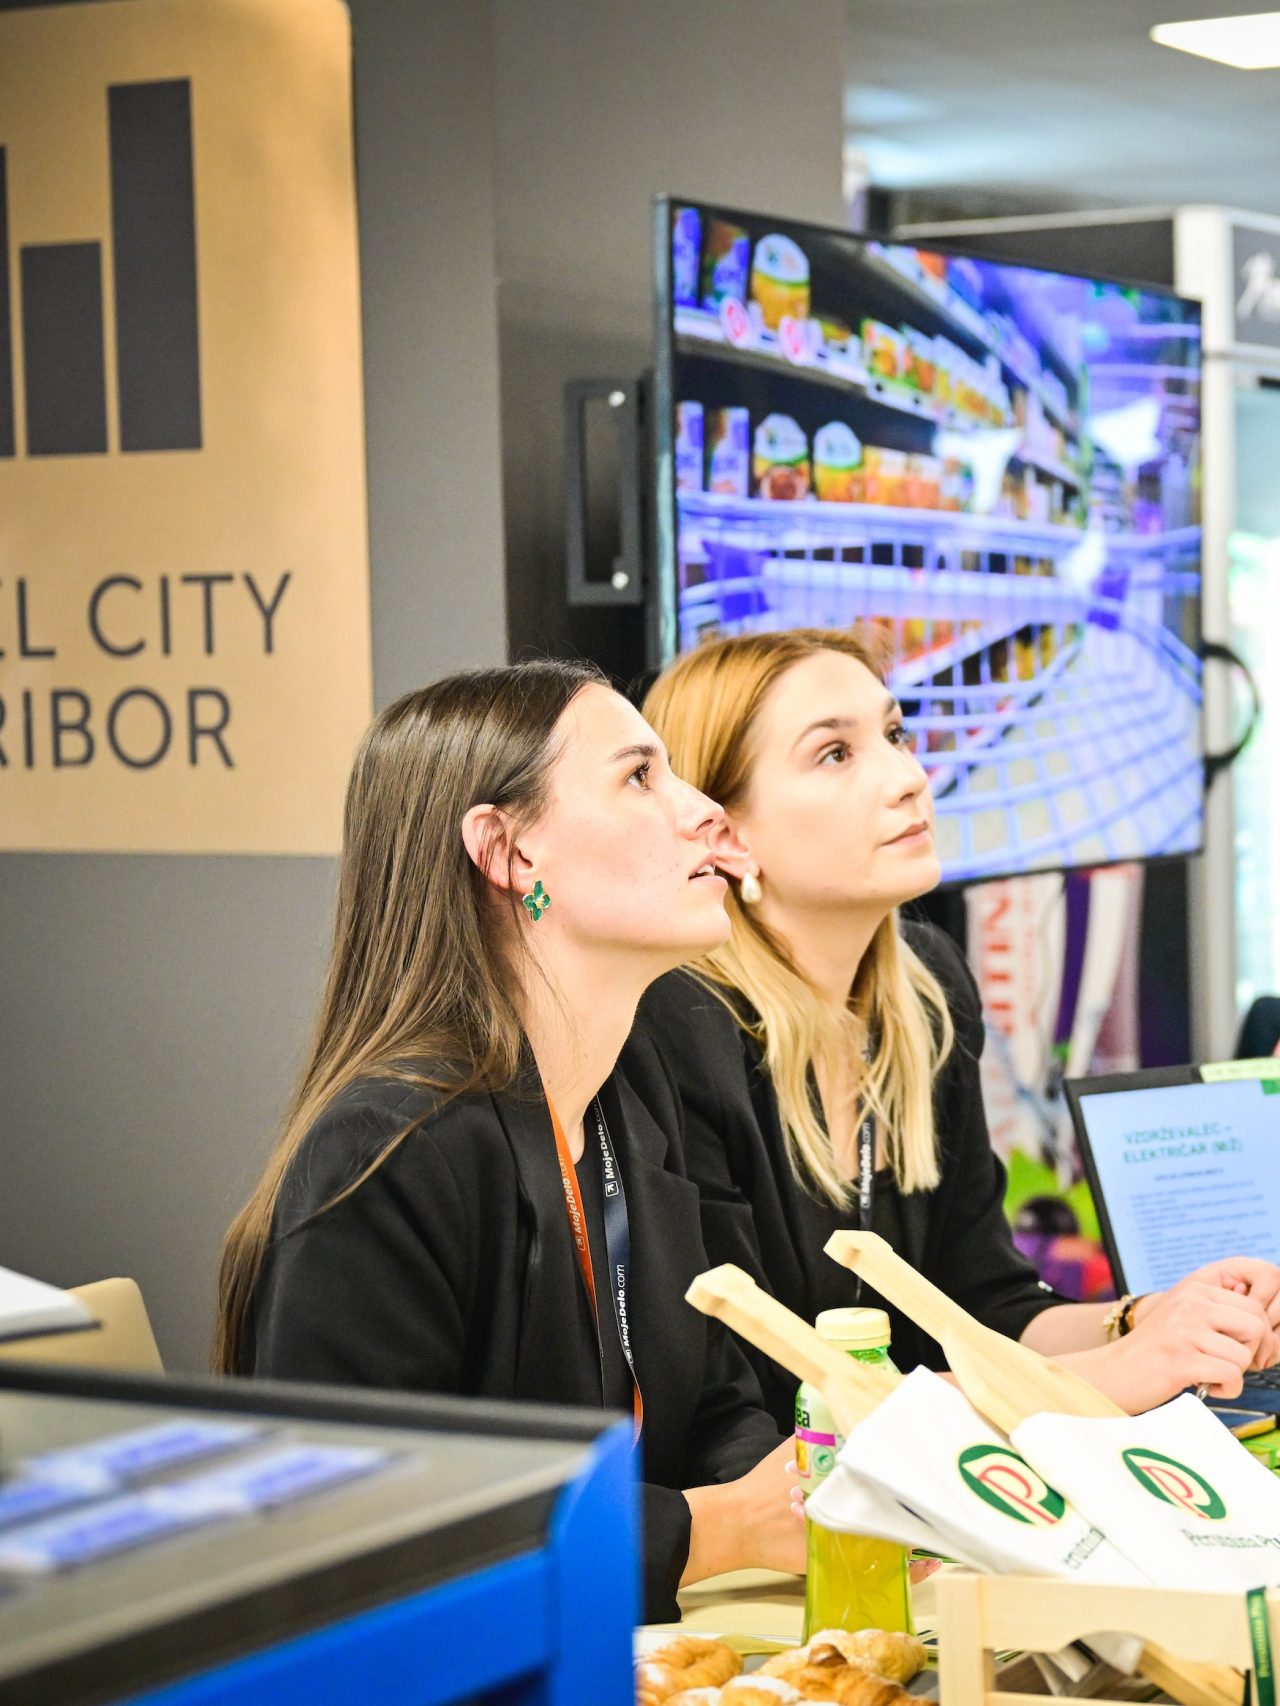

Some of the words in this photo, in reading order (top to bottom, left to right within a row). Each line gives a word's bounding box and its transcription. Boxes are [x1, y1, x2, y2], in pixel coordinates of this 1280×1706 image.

[0, 576, 57, 659] L
[88, 572, 292, 658] CITY
[0, 687, 235, 770] IBOR
[616, 1264, 631, 1347] MojeDelo.com
